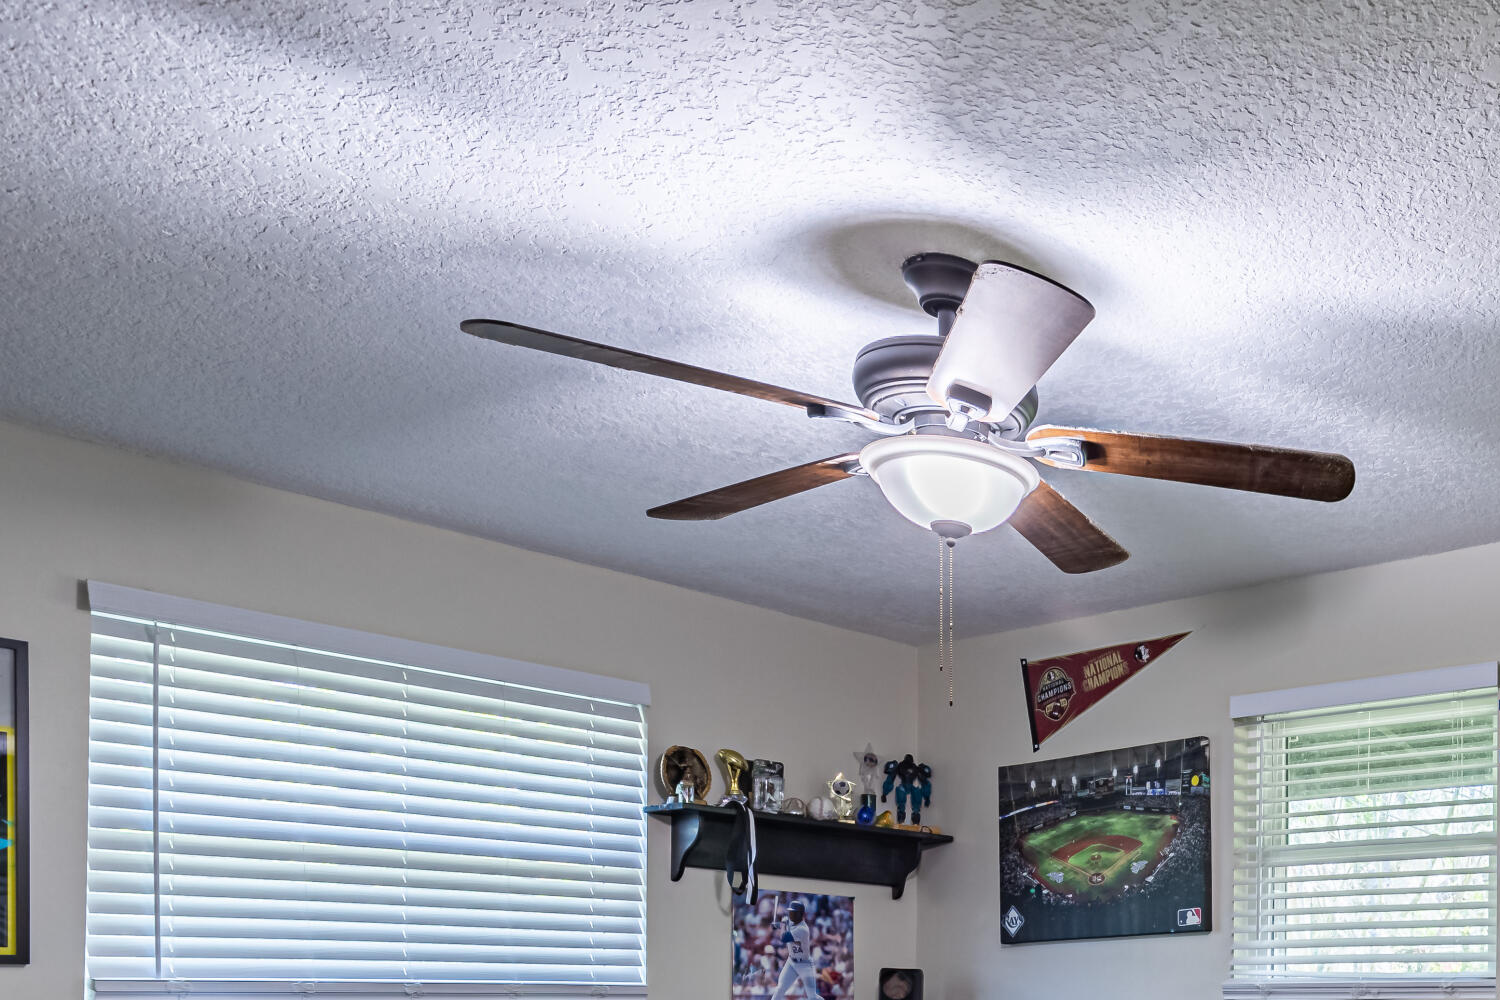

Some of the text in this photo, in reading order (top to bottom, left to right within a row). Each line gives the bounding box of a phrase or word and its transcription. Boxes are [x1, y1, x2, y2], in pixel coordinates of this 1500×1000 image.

[1083, 651, 1123, 678] NATIONAL
[1083, 661, 1129, 692] CHAMPIONS
[1038, 681, 1072, 702] CHAMPIONS
